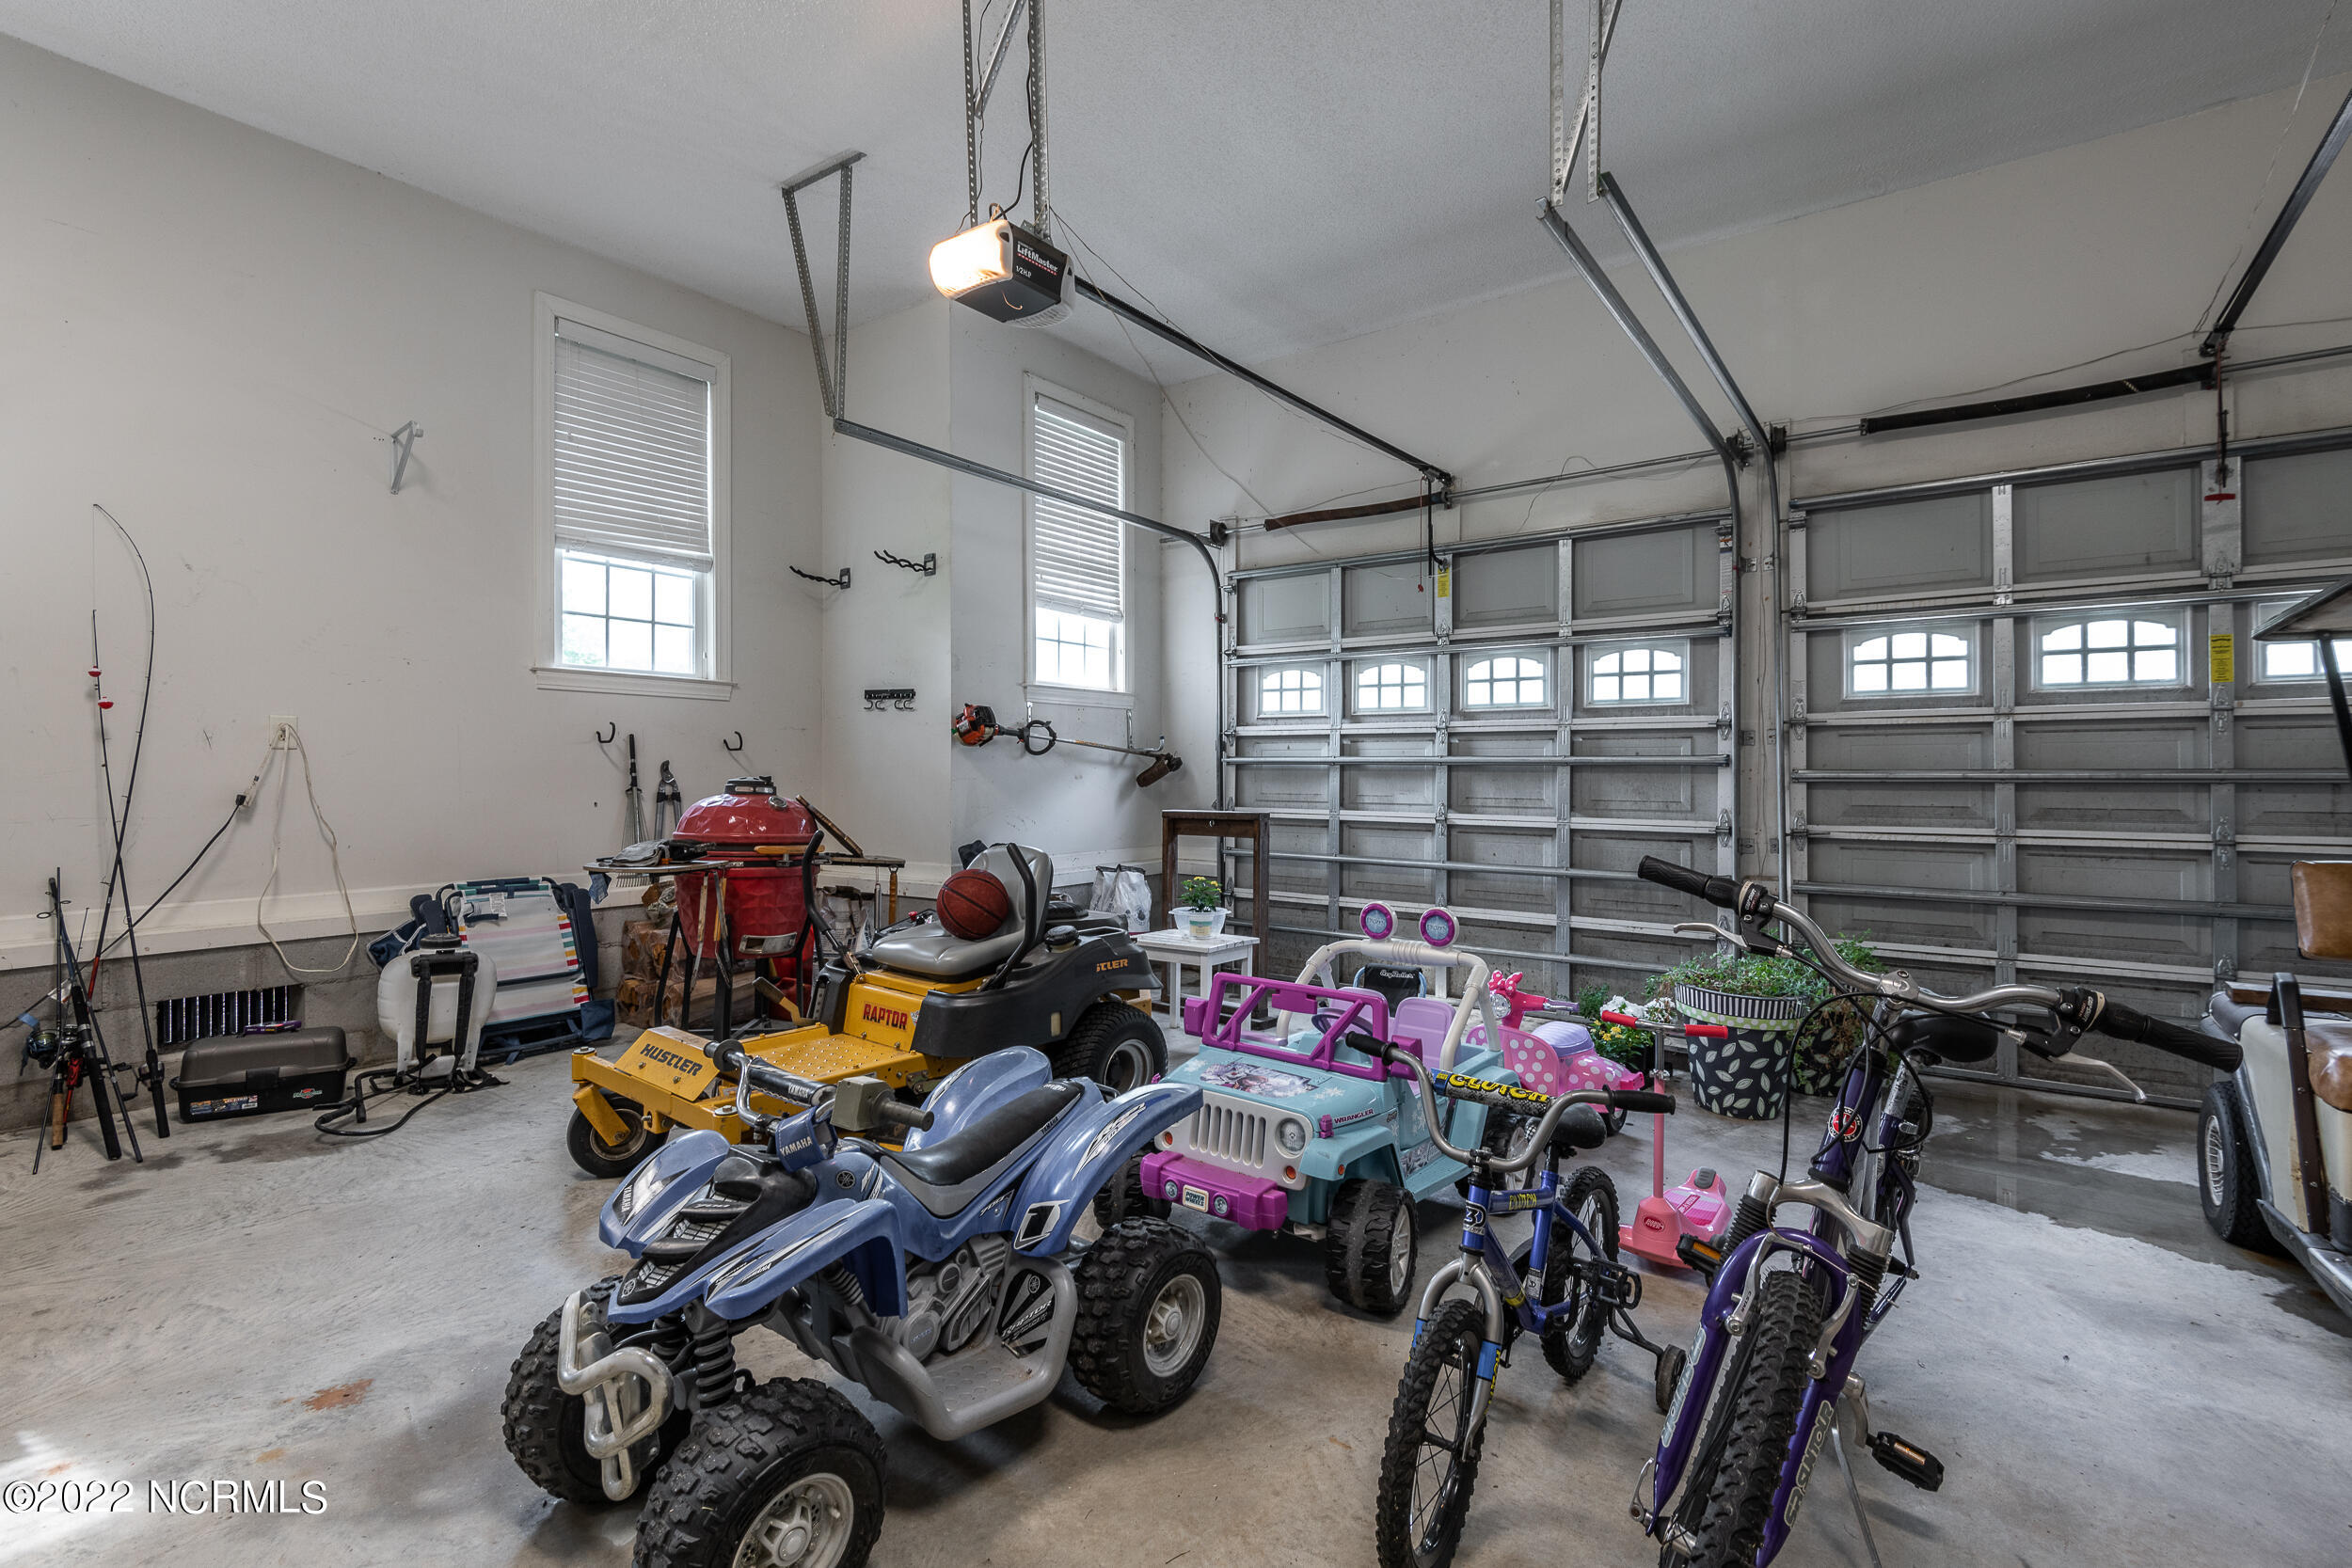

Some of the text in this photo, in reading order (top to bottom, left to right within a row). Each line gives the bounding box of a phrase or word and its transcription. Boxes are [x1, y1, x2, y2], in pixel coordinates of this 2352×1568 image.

[1017, 244, 1058, 272] LiftMaster
[863, 1004, 908, 1030] RAPTOR
[640, 1043, 703, 1076] HUSTLER
[1334, 1108, 1374, 1124] WRANGLER
[780, 1136, 812, 1156] YAMAHA
[621, 1185, 632, 1212] YAMAHA
